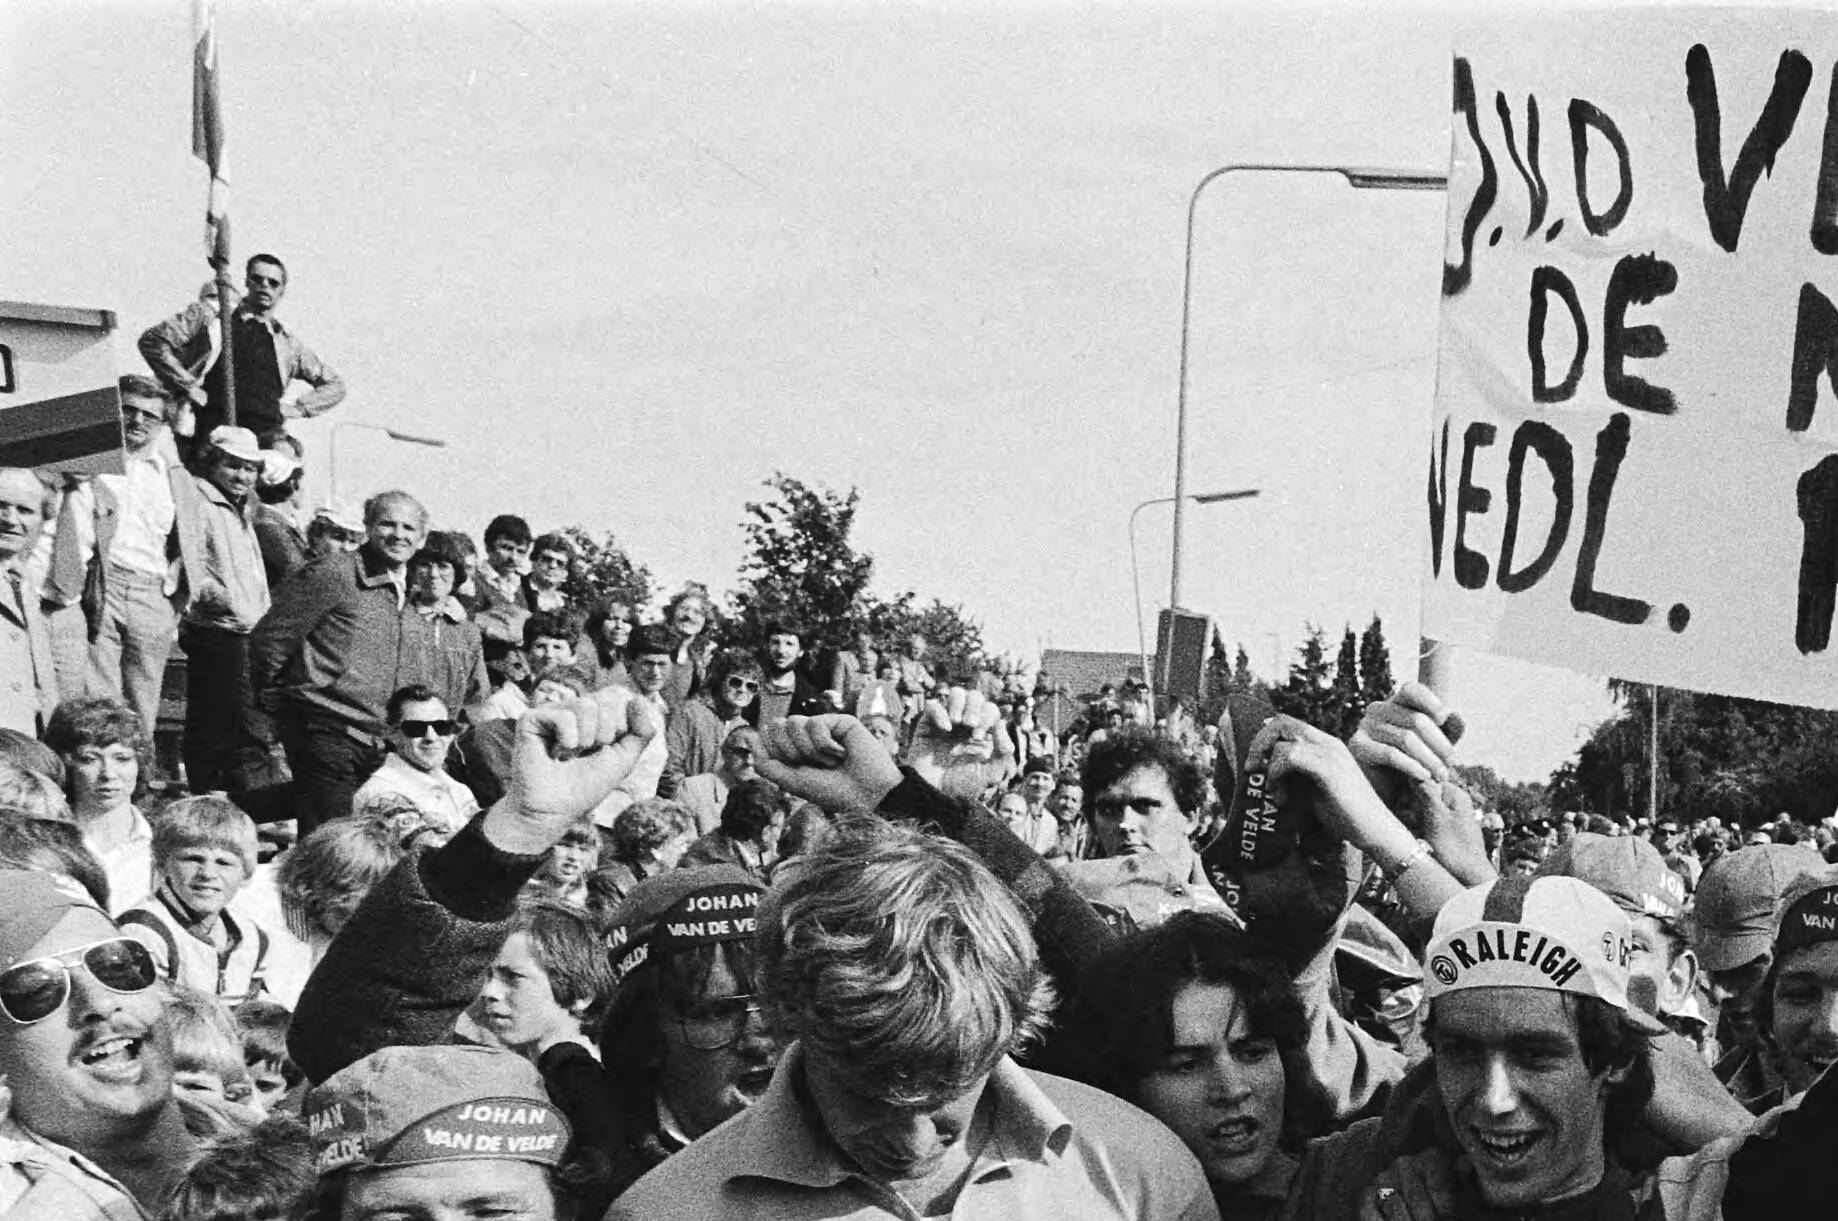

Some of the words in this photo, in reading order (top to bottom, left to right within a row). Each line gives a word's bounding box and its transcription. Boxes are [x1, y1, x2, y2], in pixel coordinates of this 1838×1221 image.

[1527, 251, 1678, 415] DE
[685, 891, 760, 913] JOHAN
[666, 921, 706, 937] VAN
[707, 919, 730, 936] DE
[1802, 912, 1836, 931] VAN
[1448, 928, 1583, 988] RALEIGH
[457, 1103, 548, 1125] JOHAN
[423, 1126, 473, 1151] VAN
[474, 1133, 501, 1152] DE
[506, 1133, 558, 1153] VELDE
